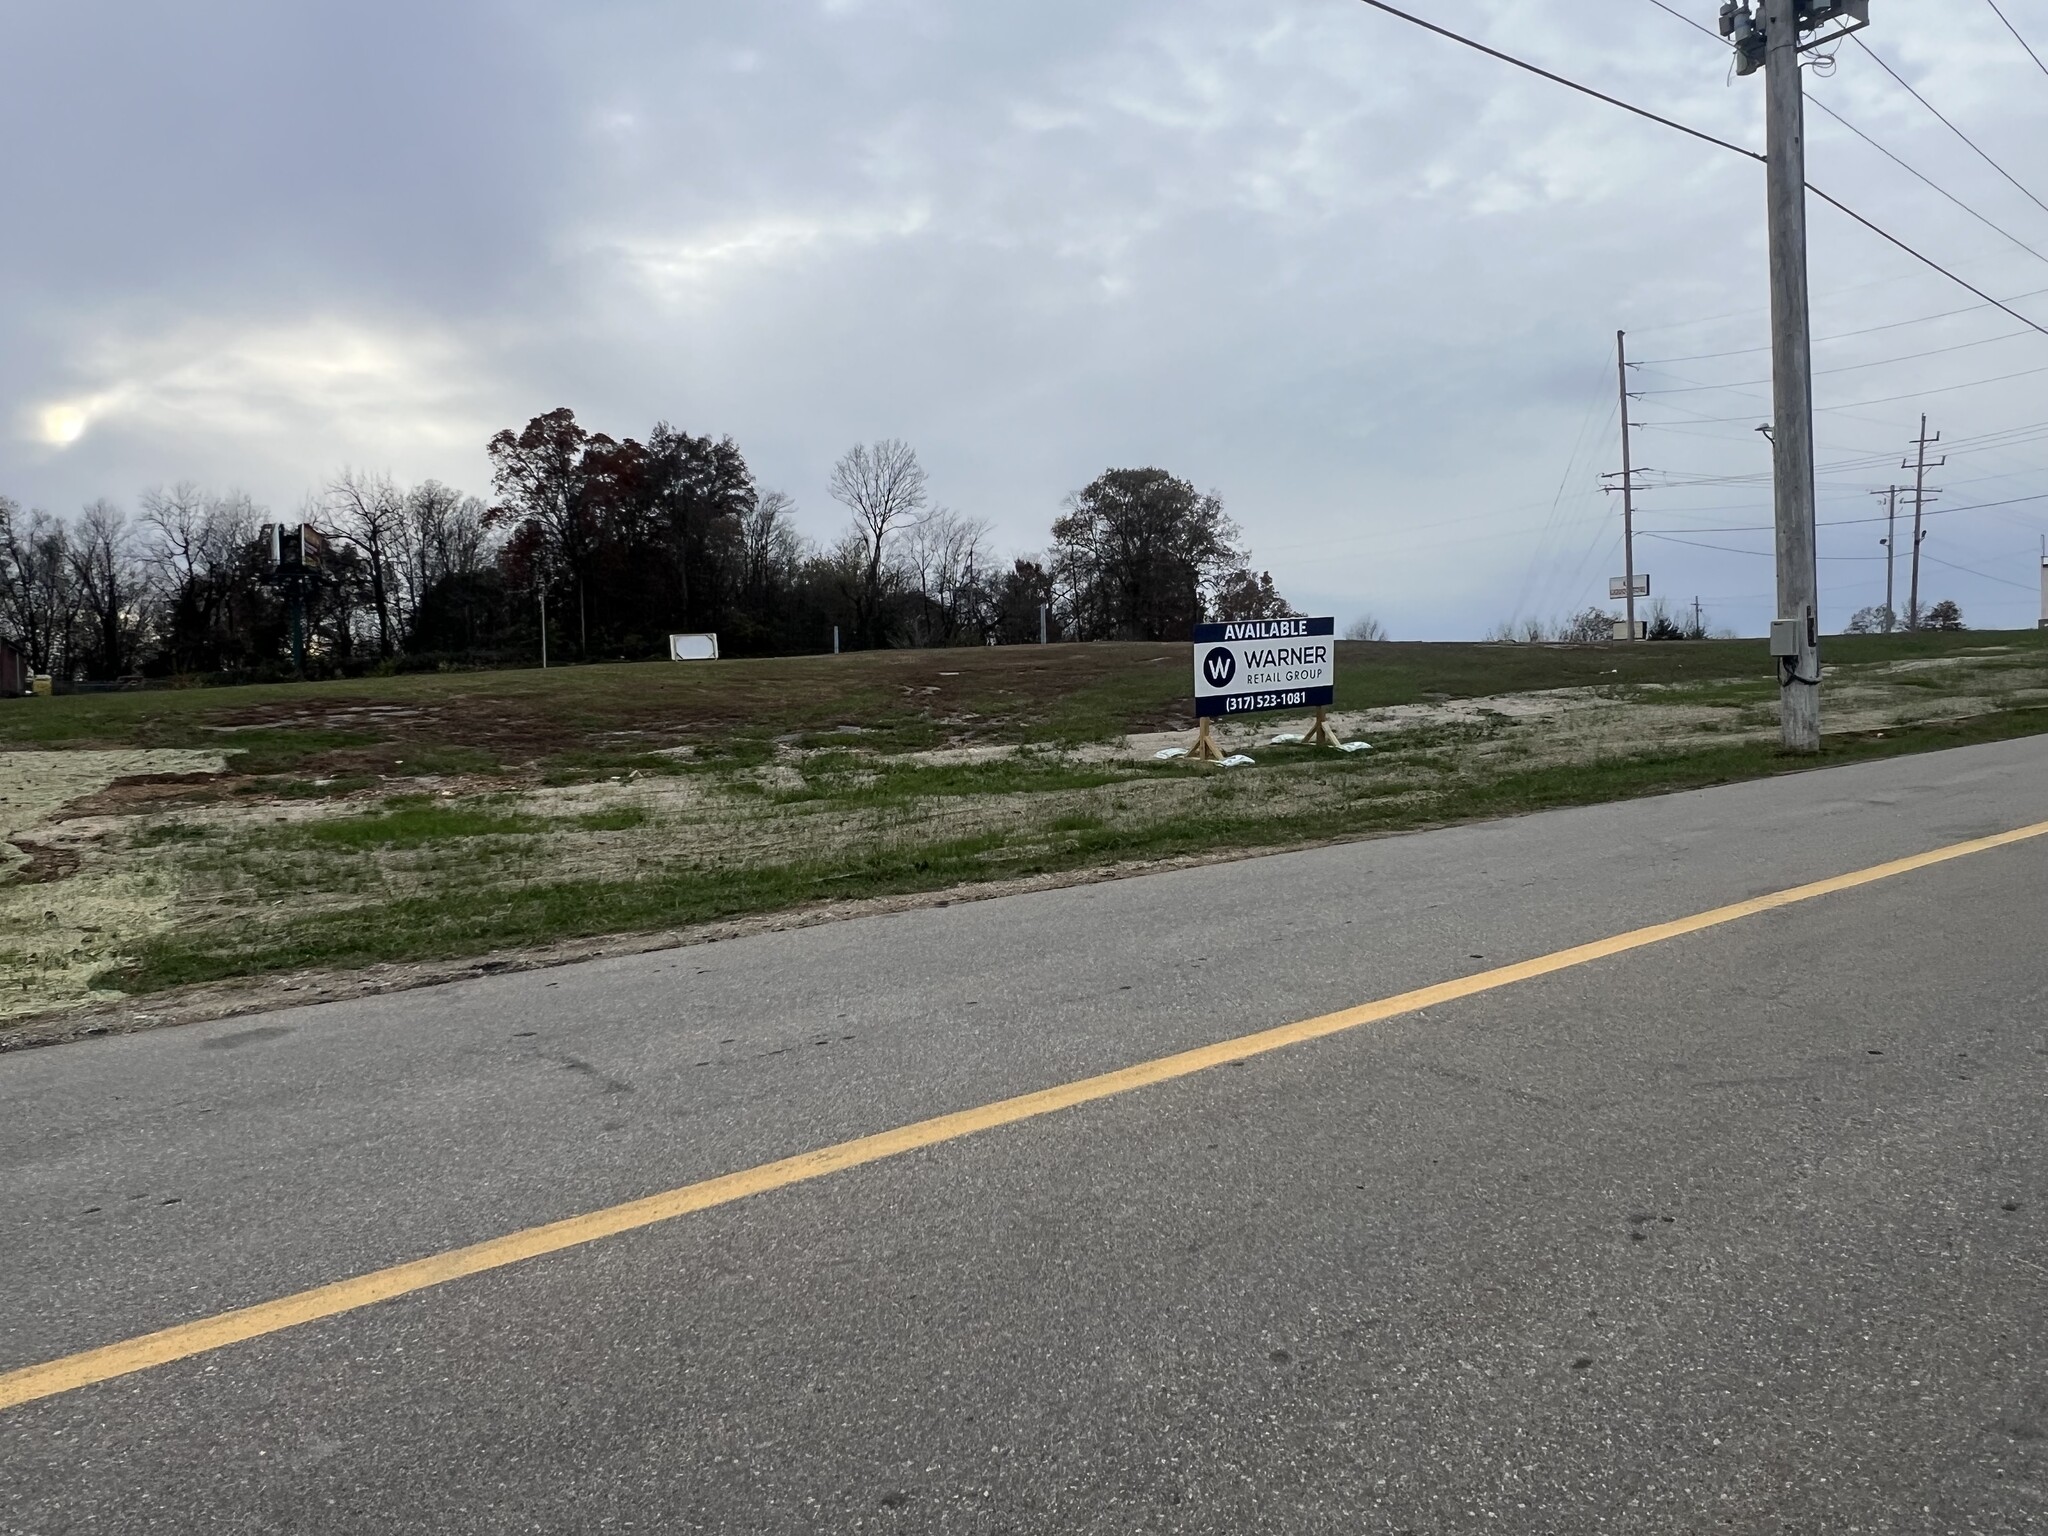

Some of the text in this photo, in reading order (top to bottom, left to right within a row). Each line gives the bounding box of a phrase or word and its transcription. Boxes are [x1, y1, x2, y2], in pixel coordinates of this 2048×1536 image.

[1224, 620, 1307, 640] AVAILABLE
[1208, 656, 1231, 680] W
[1244, 646, 1327, 669] WARNER
[1247, 669, 1322, 684] RETAIL GROUP
[1226, 691, 1306, 712] (317) 523-1081
